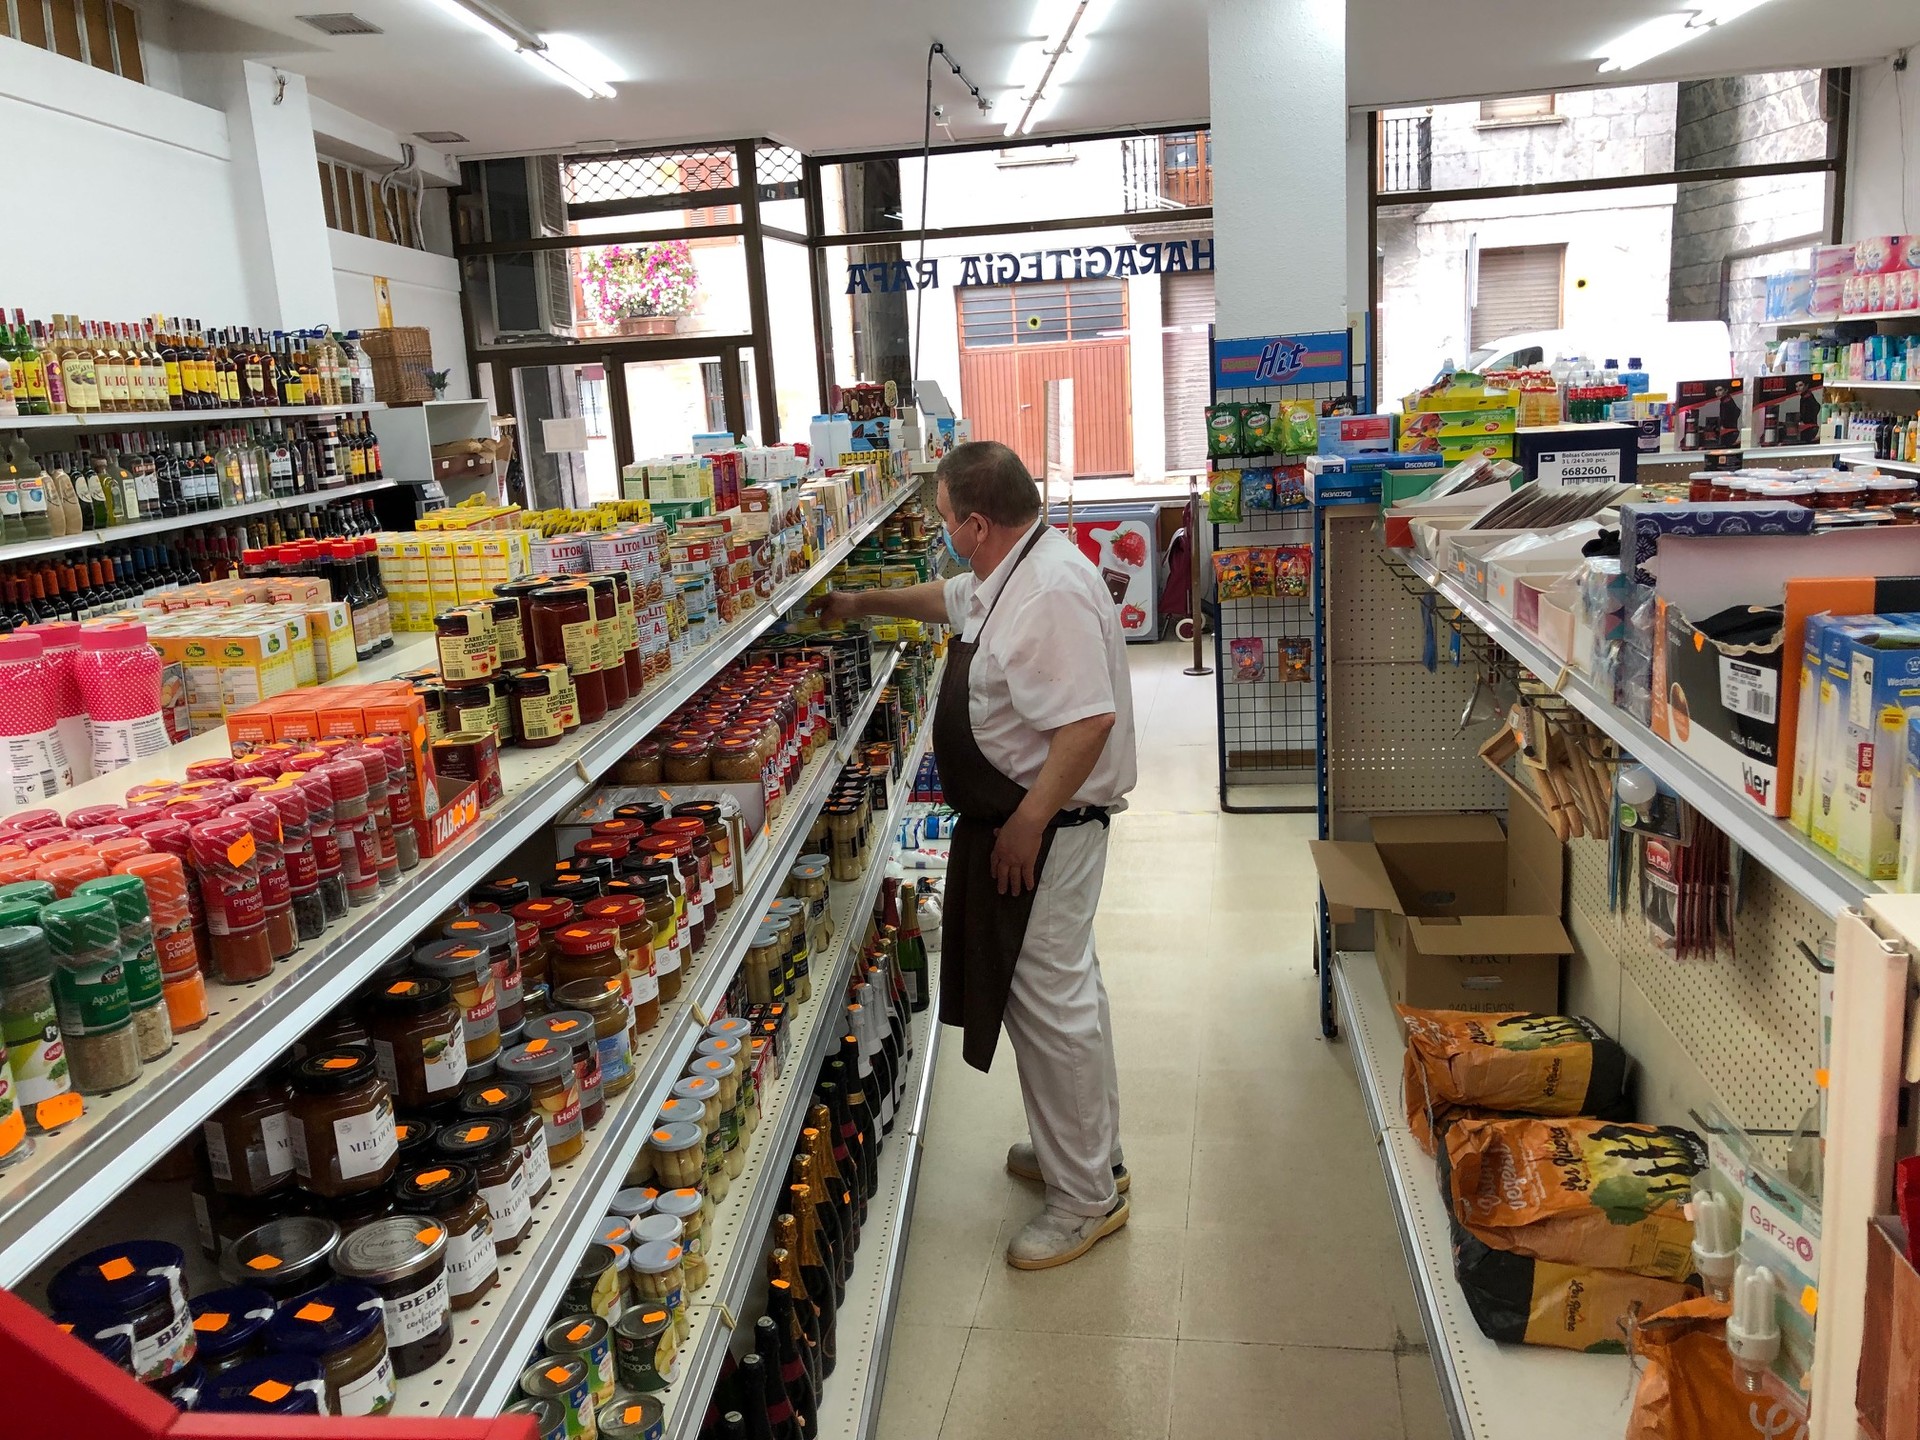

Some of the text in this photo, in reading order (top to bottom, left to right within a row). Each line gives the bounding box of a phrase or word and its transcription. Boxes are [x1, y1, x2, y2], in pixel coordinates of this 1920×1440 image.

[1255, 341, 1308, 381] Hit
[1561, 466, 1608, 476] 6682606
[1747, 736, 1773, 758] ÚNICA
[1861, 747, 1873, 768] OPEN
[1742, 762, 1770, 796] kler
[435, 790, 476, 846] TABSO
[1648, 853, 1657, 863] La
[585, 939, 611, 952] Helios
[1551, 1126, 1591, 1192] Los Rivera
[1750, 1205, 1796, 1252] Garza
[1566, 1279, 1584, 1332] Los Rivera
